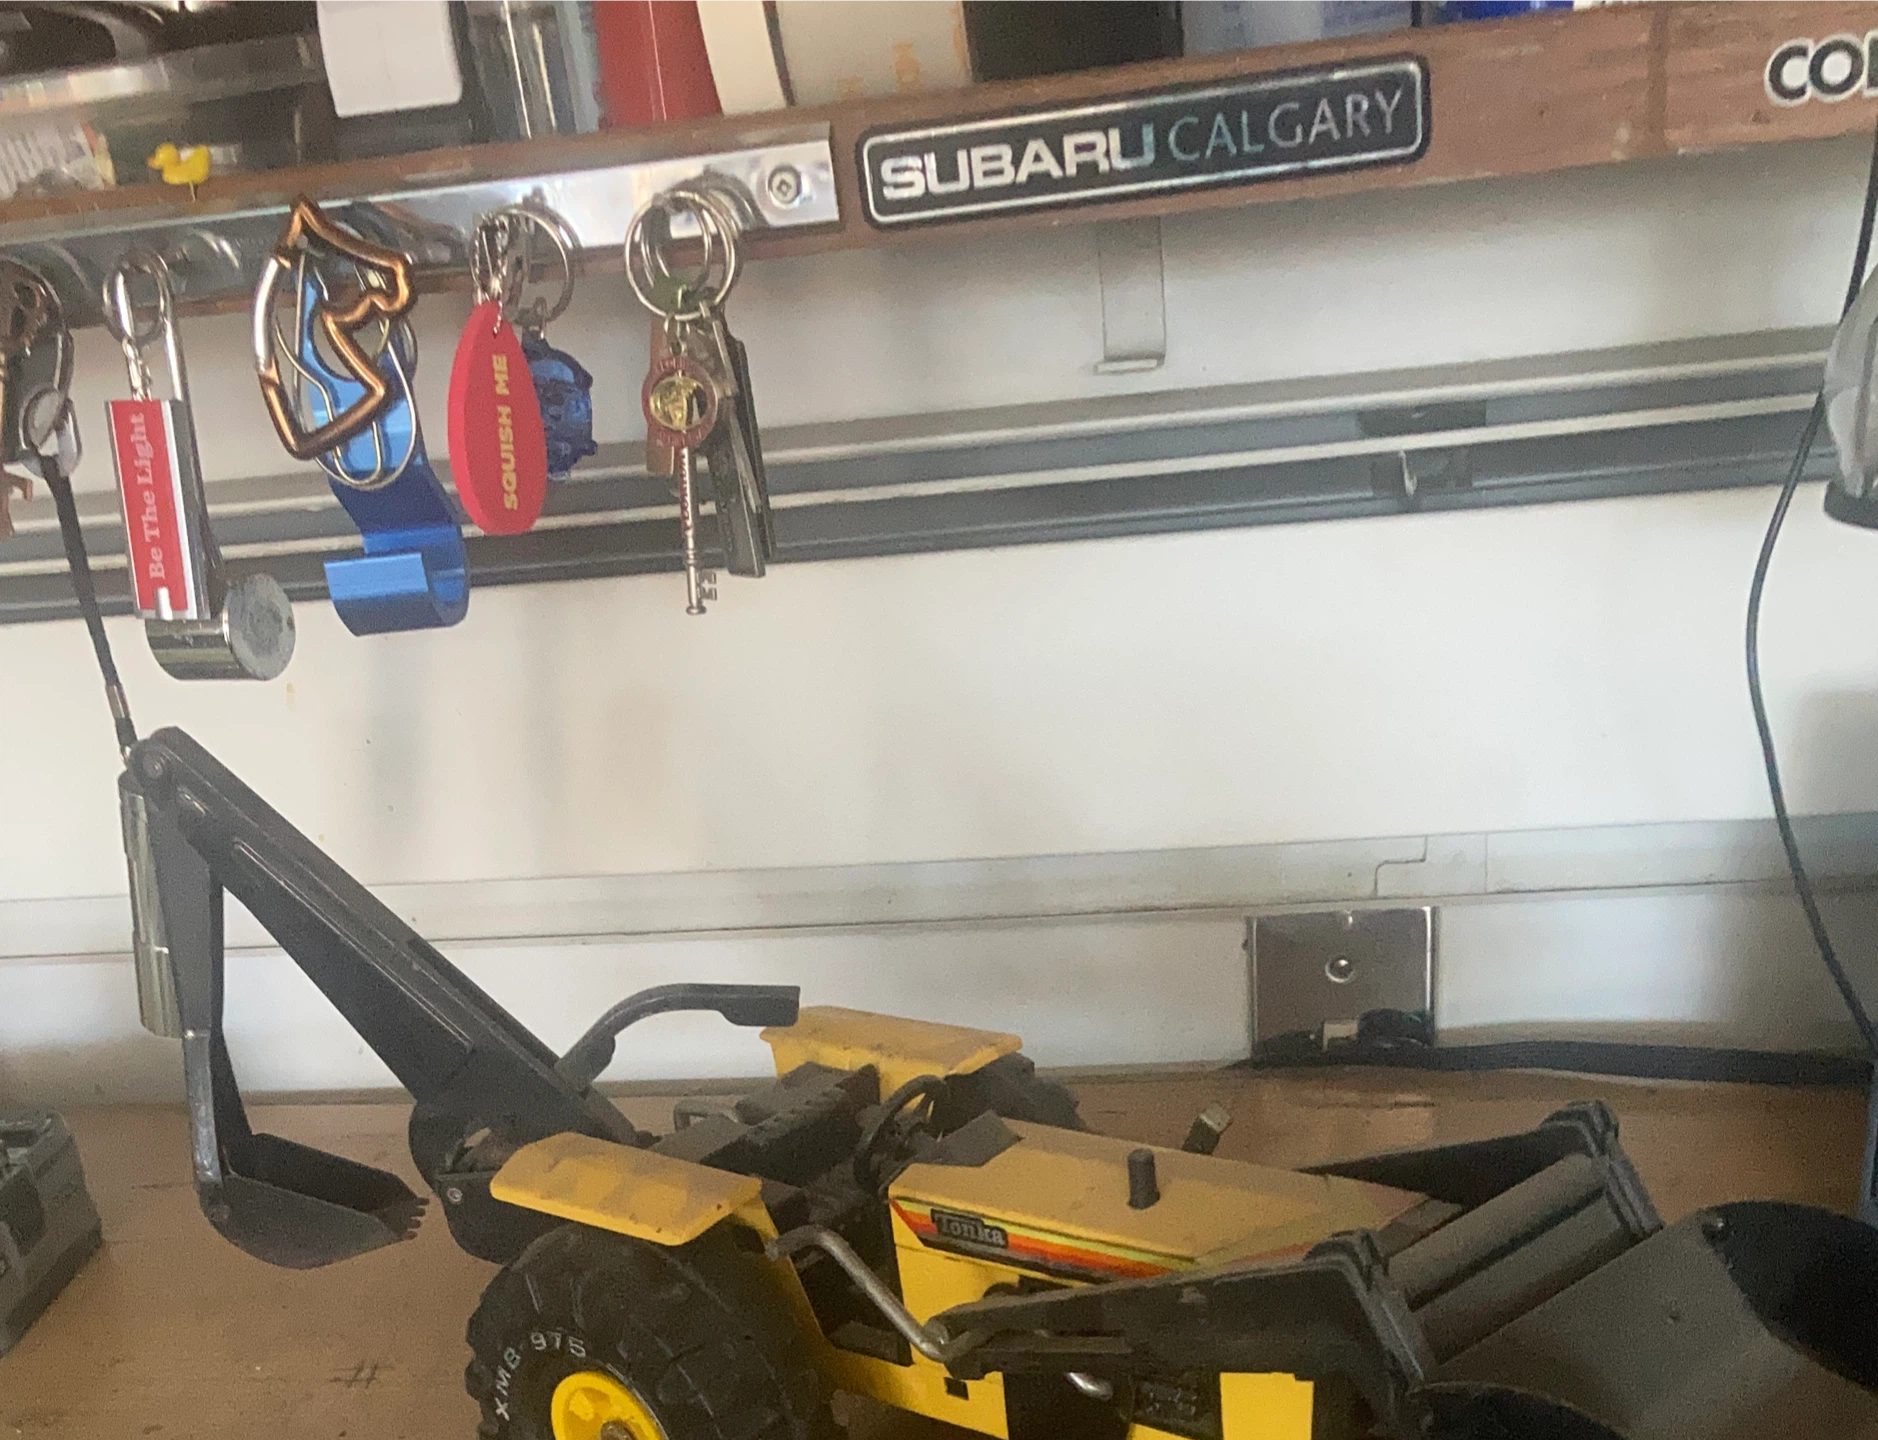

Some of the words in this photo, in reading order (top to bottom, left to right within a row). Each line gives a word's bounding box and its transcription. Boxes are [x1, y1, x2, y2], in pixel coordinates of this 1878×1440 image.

[880, 123, 1155, 201] SUBARU
[1167, 89, 1402, 162] CALGARY
[492, 354, 510, 395] ME
[130, 411, 155, 485] Light
[497, 405, 519, 511] SQUISH
[141, 490, 160, 539] The
[149, 546, 166, 579] Be
[936, 1214, 1006, 1244] Tonka
